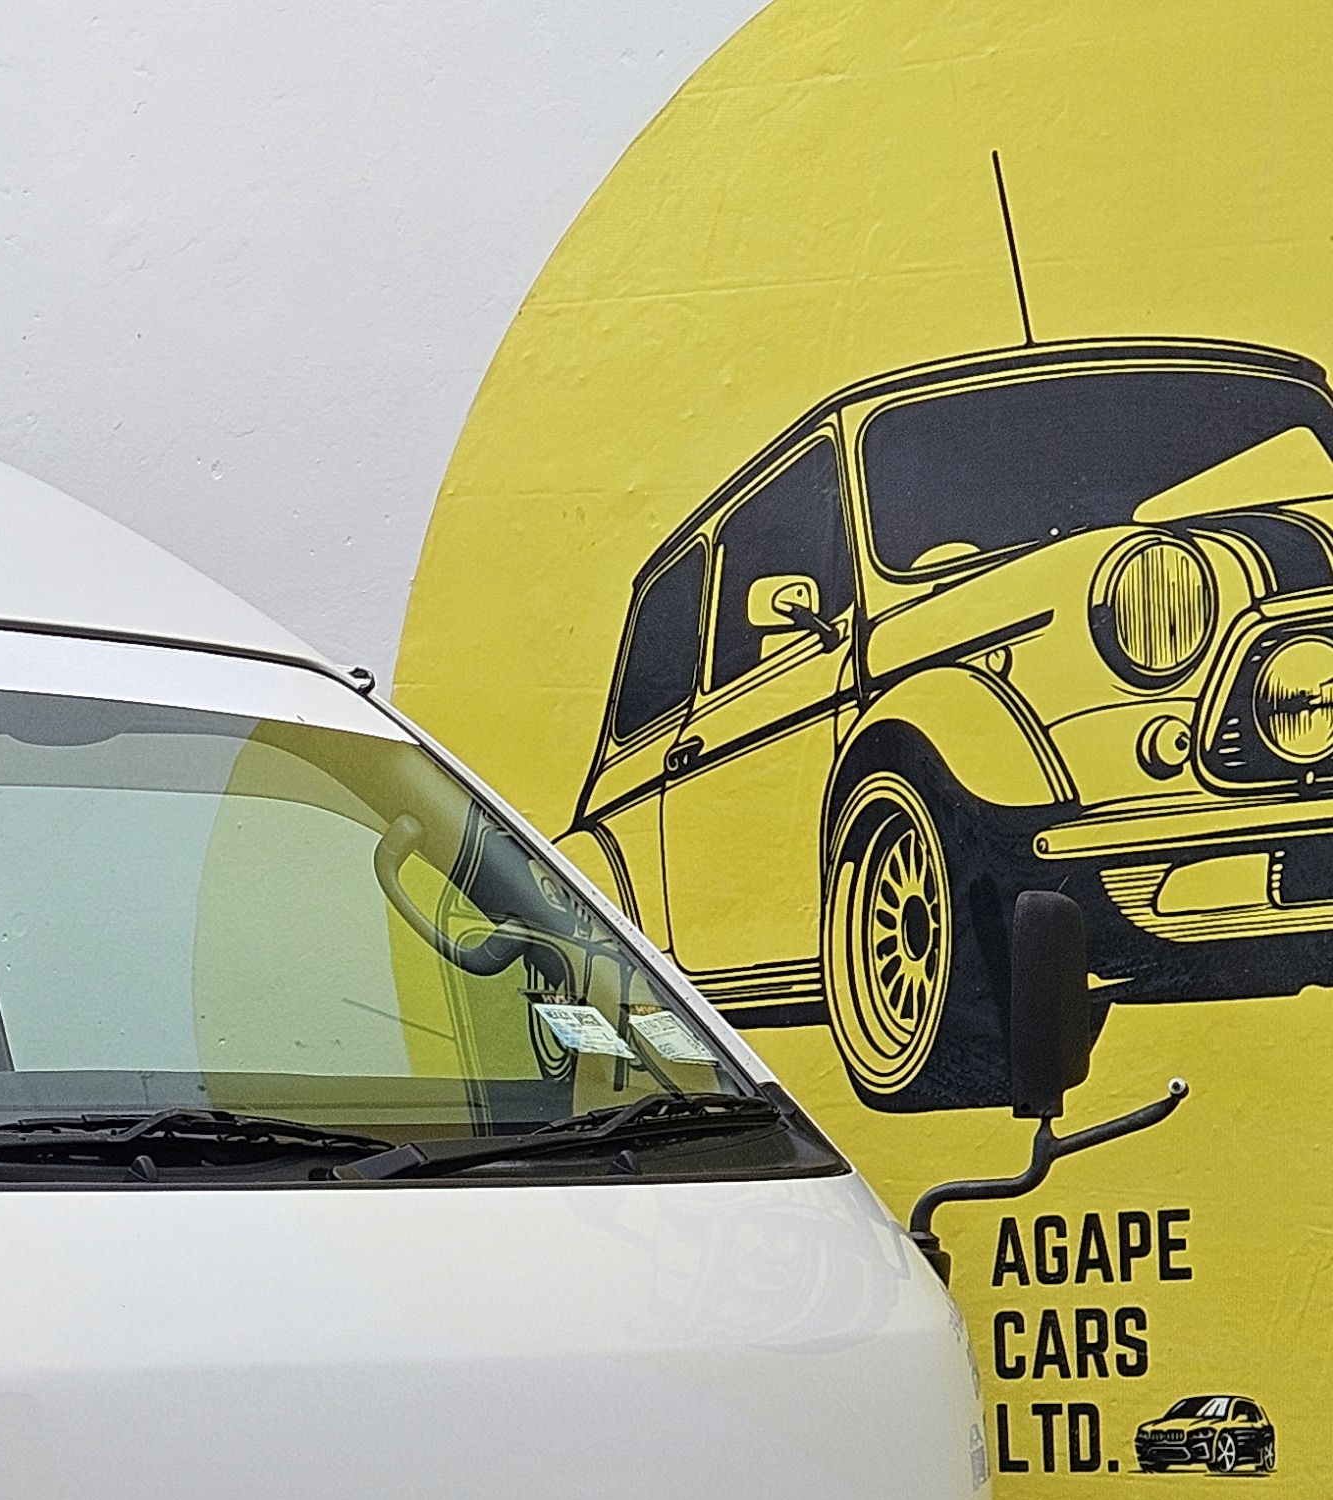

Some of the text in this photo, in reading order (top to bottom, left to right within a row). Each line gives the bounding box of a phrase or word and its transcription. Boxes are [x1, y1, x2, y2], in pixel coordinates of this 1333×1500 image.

[991, 1208, 1193, 1287] AGAPE
[993, 1306, 1150, 1380] CARS
[995, 1402, 1120, 1474] LTD.
